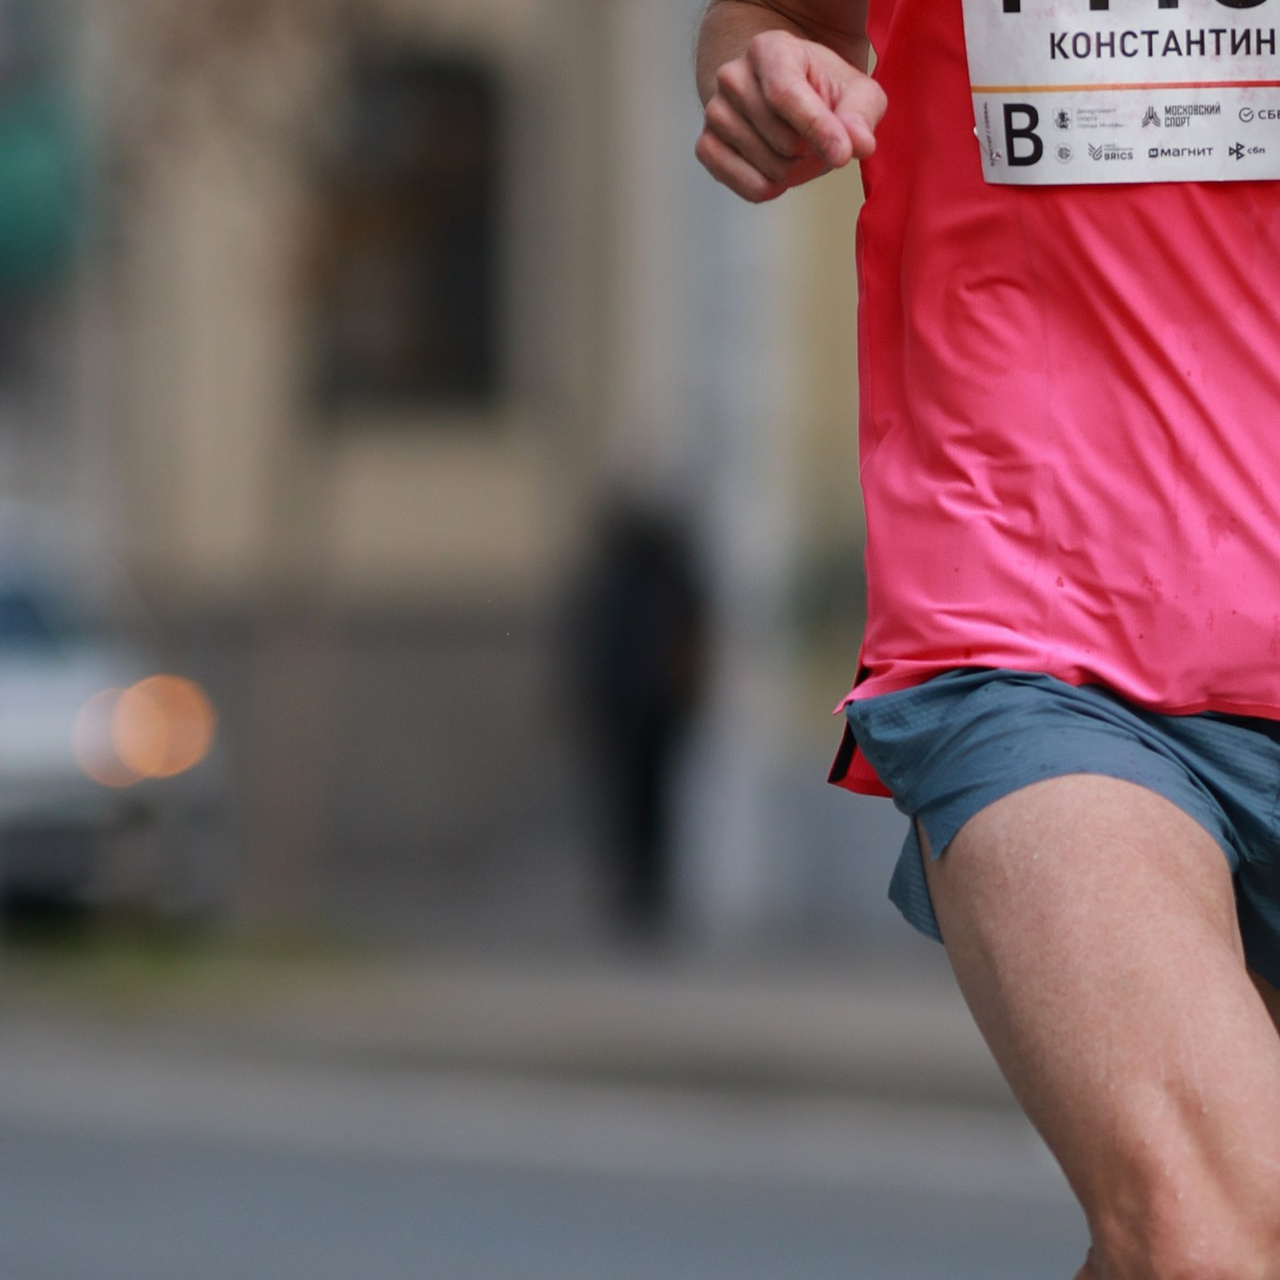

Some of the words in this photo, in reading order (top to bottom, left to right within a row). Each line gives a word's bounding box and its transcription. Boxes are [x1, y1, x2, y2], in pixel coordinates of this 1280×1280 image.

[1050, 28, 1276, 60] КОНСТАНТИН
[1164, 102, 1221, 116] МОСКОВСКИЙ
[1164, 117, 1191, 128] СПОРТ
[1003, 103, 1043, 167] B
[1104, 152, 1133, 161] BRICS
[1247, 146, 1266, 155] сбп
